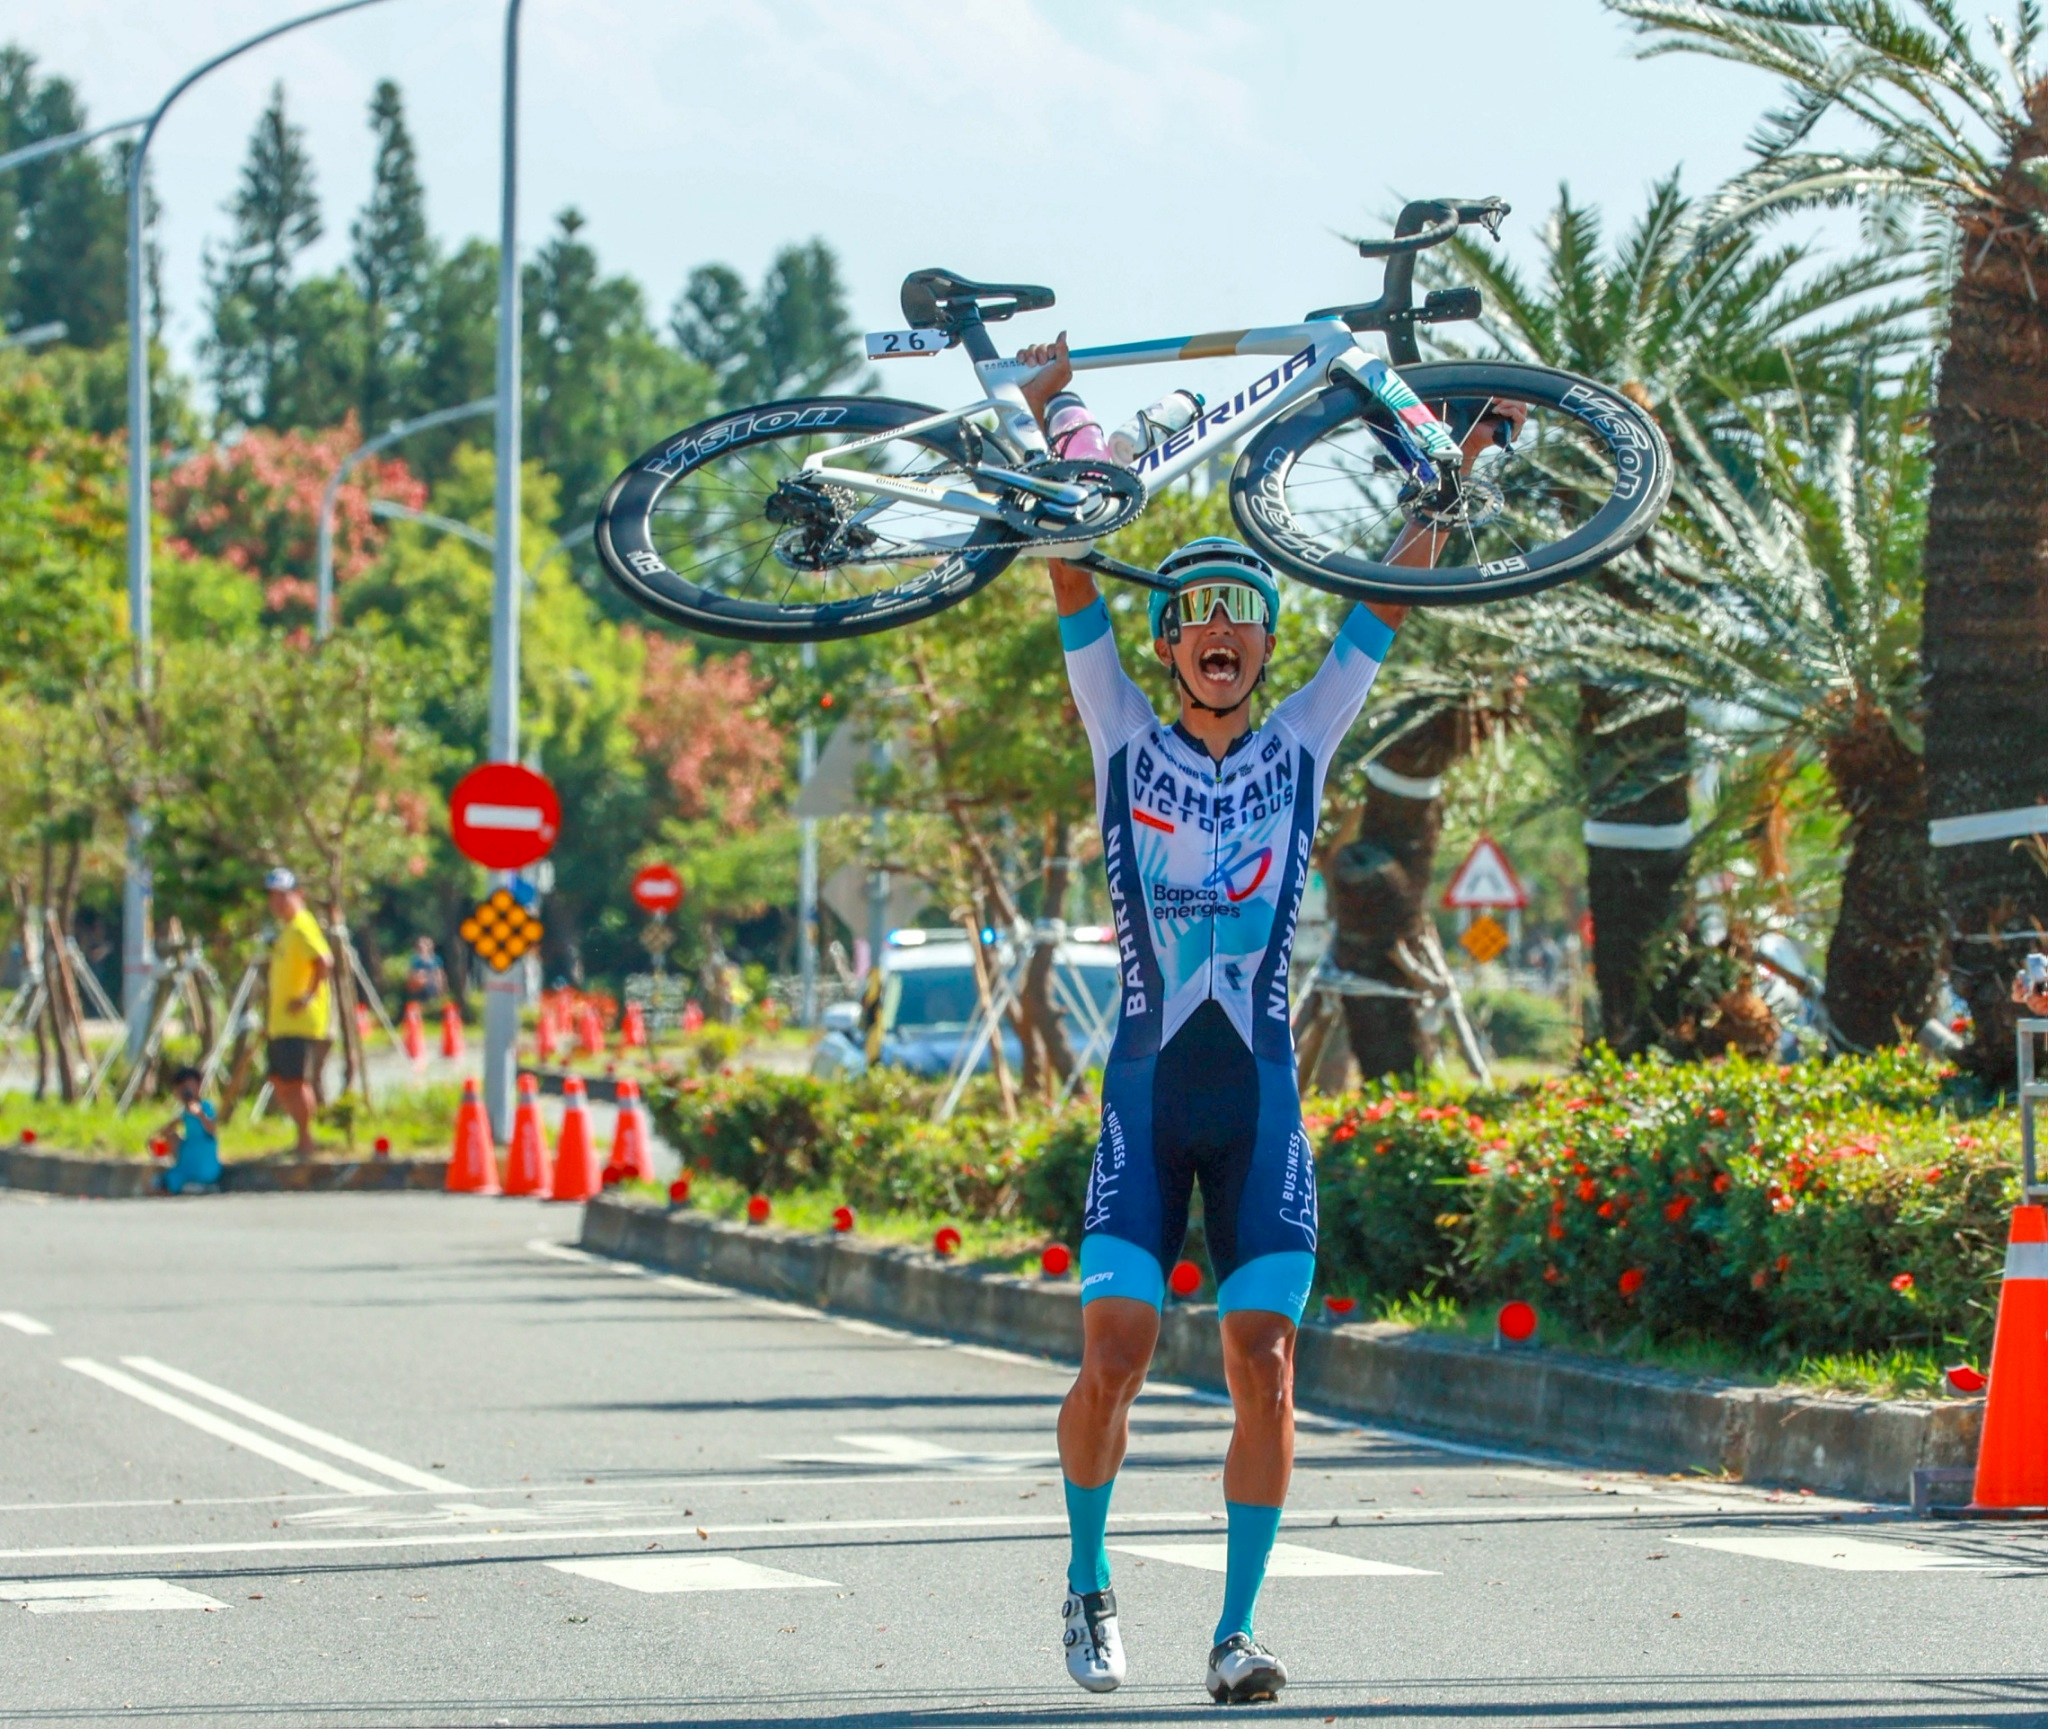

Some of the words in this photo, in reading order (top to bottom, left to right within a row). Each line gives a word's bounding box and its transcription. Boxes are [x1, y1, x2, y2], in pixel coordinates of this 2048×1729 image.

[643, 407, 847, 479] Vision
[1127, 343, 1317, 475] MERIDA
[1559, 385, 1650, 499] Vision
[1133, 778, 1294, 834] VICTORIOUS
[1135, 746, 1293, 819] BAHRAIN
[1107, 824, 1146, 1017] BAHRAIN
[1153, 902, 1241, 919] energies
[1154, 884, 1218, 905] Bapco
[1267, 829, 1309, 1021] BAHRAIN
[1107, 1110, 1125, 1170] BUSINESS
[1282, 1132, 1301, 1202] BUSINESS
